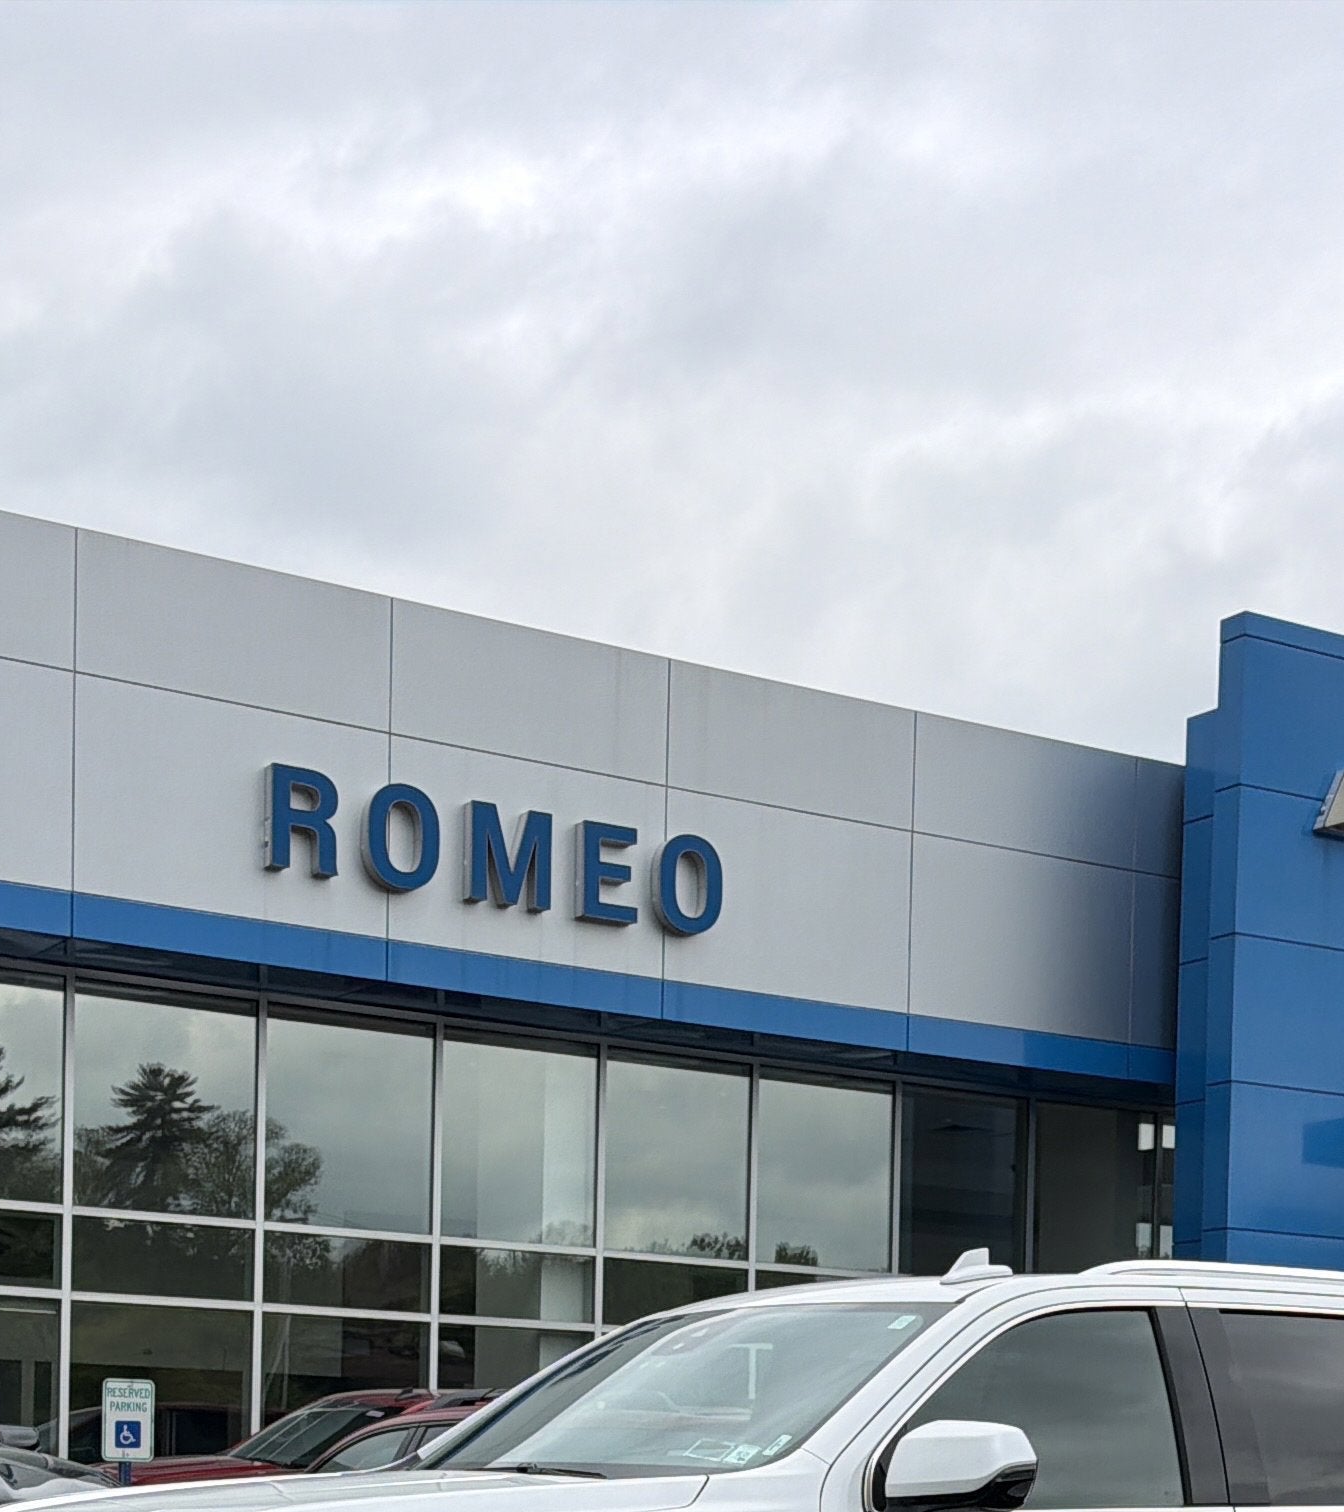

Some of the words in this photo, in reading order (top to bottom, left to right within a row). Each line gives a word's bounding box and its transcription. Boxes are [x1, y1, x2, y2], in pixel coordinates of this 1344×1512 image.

[264, 762, 723, 937] ROMEO
[106, 1387, 151, 1399] RESERVED
[110, 1400, 148, 1412] PARKING
